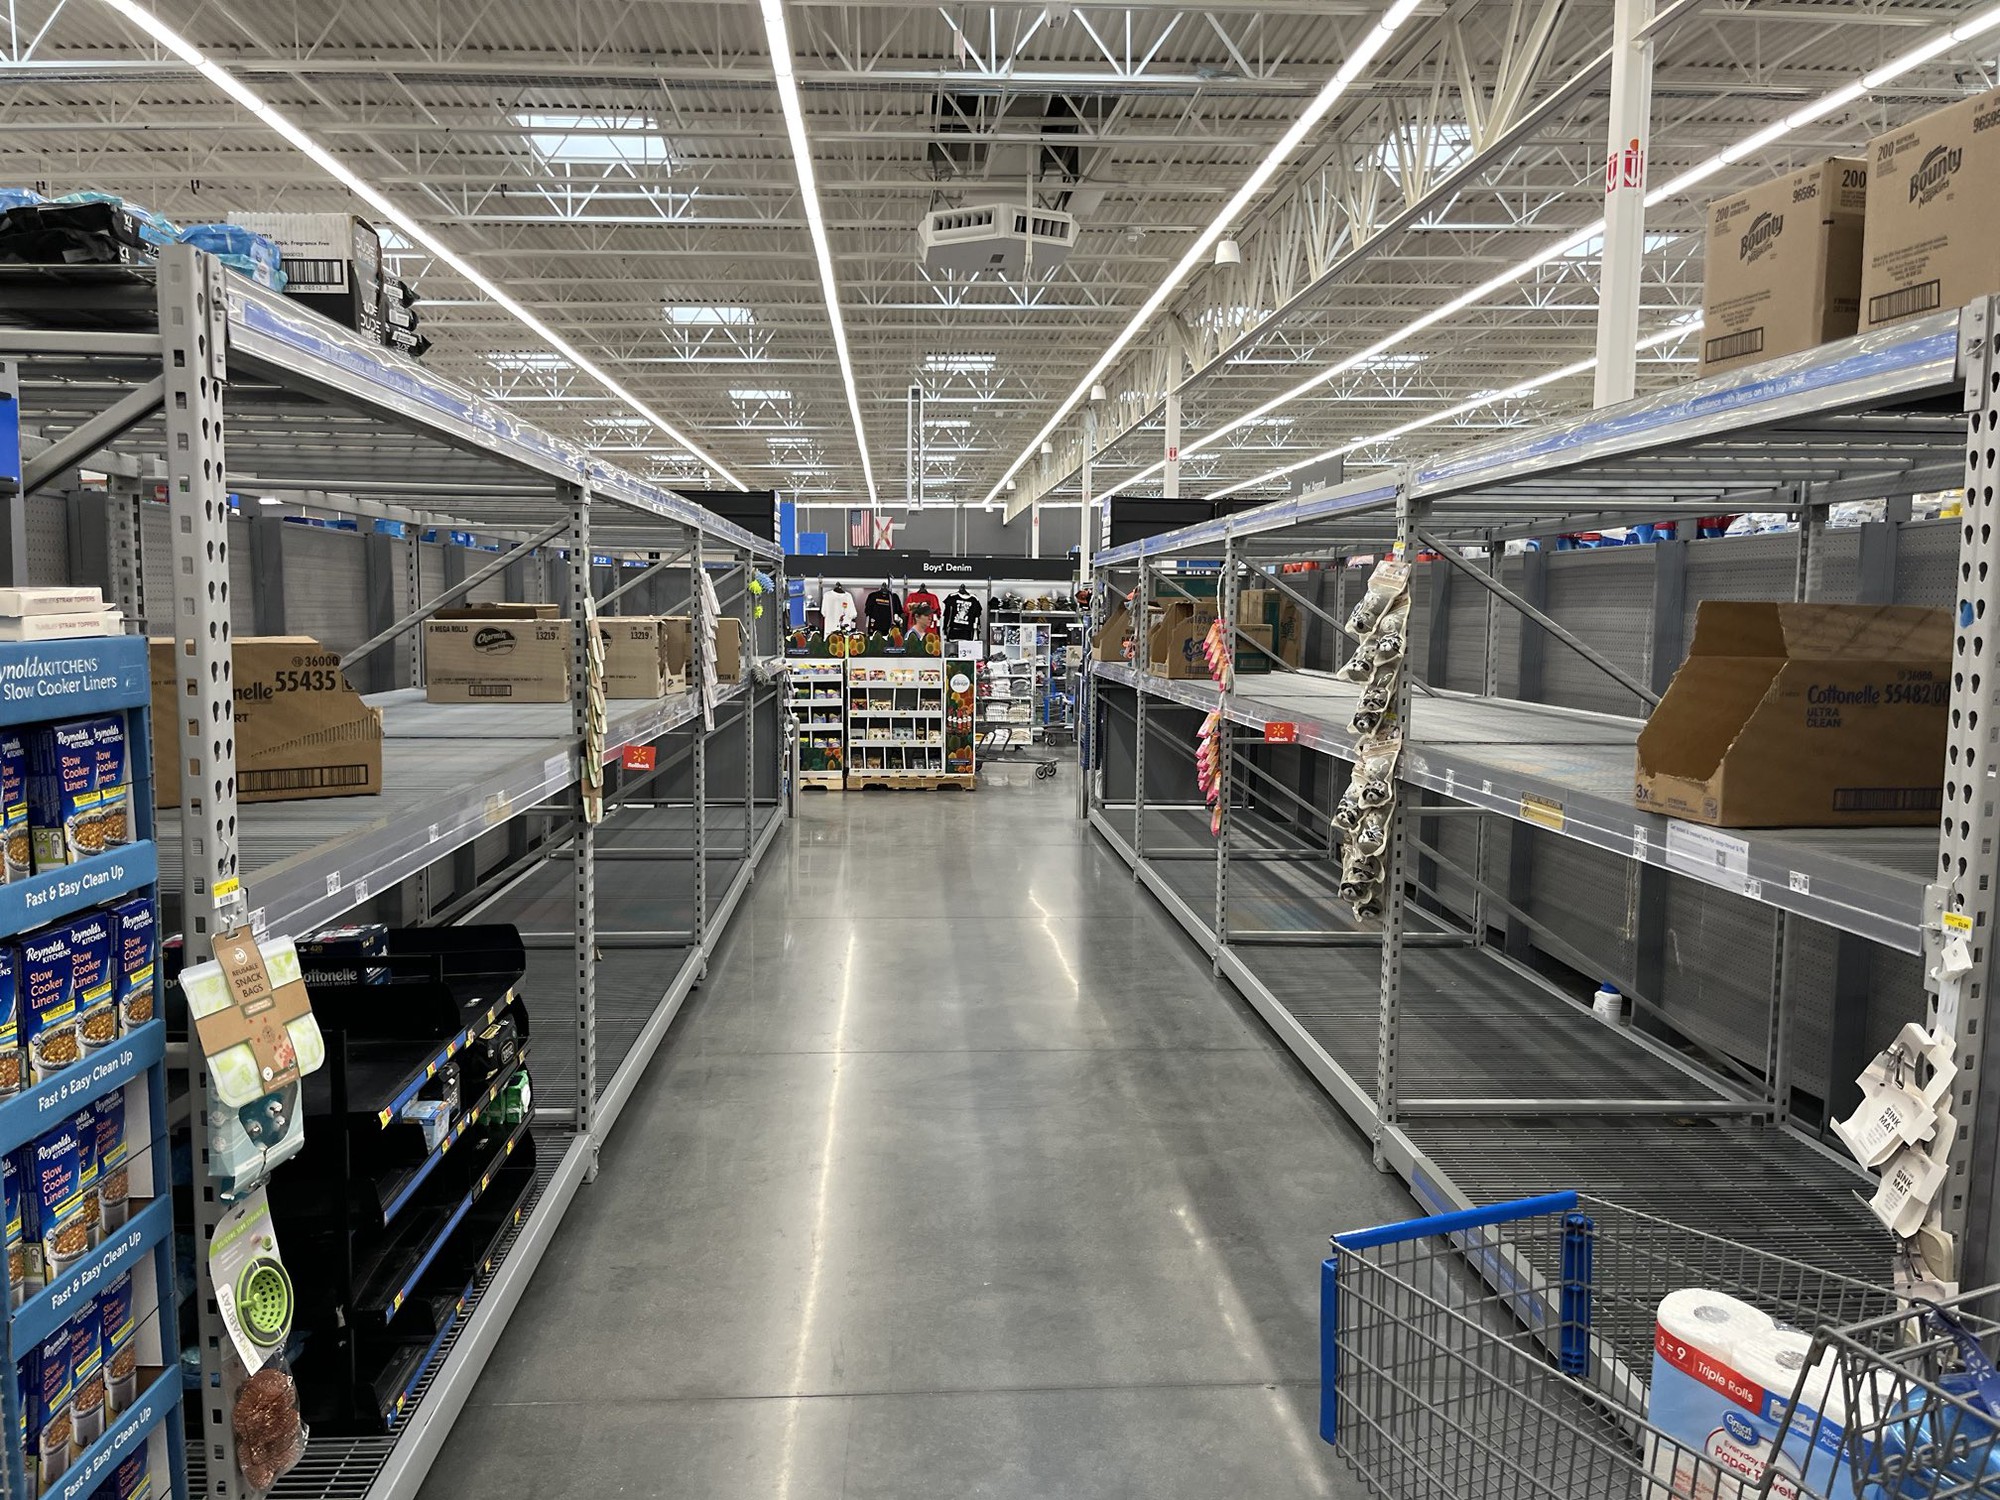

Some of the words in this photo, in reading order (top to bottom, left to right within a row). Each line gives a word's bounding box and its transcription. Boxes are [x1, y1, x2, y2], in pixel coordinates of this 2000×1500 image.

[1878, 142, 1894, 161] 200
[1842, 169, 1867, 188] 200
[1909, 147, 1962, 204] Bounty
[1715, 206, 1729, 223] 200
[1740, 213, 1784, 260] Bounty
[360, 313, 381, 334] DUDE
[361, 330, 381, 344] WIPES
[1753, 388, 1762, 397] on
[1764, 384, 1774, 395] the
[599, 556, 607, 564] 22
[923, 562, 944, 573] Boys'
[946, 562, 972, 573] Denim
[74, 595, 95, 603] TOPPERS
[77, 620, 100, 628] TOPPERS
[435, 625, 450, 633] MEGA
[452, 625, 469, 633] ROLLS
[477, 631, 507, 644] Charmin
[536, 631, 556, 640] 13219
[630, 631, 649, 640] 13219
[305, 656, 339, 667] 36000
[4, 682, 35, 701] Slow
[37, 677, 80, 698] Cooker
[83, 675, 117, 692] Liners
[275, 670, 336, 692] 55435
[233, 682, 274, 700] nelle
[1807, 684, 1881, 705] Cottonelle
[1884, 684, 1931, 705] 55482
[1807, 708, 1839, 717] ULTRA
[1807, 718, 1841, 728] CLEAN
[57, 729, 88, 746] Reynolds
[71, 739, 94, 749] KITCHENS
[102, 734, 124, 744] KITCHENS
[62, 756, 81, 768] Slow
[63, 766, 90, 779] Cooker
[64, 779, 88, 792] Liners
[26, 889, 48, 908] Fast
[49, 886, 57, 900] &
[58, 881, 81, 898] Easy
[82, 871, 110, 889] Clean
[110, 865, 124, 879] Up
[122, 909, 150, 929] Reynolds
[134, 917, 153, 931] KITCHENS
[82, 931, 107, 945] KITCHENS
[124, 937, 141, 950] Slow
[25, 940, 65, 962] Reynolds
[42, 948, 71, 964] KITCHENS
[72, 951, 92, 965] Slow
[124, 944, 147, 960] Cooker
[72, 960, 101, 977] Cooker
[124, 957, 144, 972] Liners
[232, 963, 259, 976] REUSABLE
[30, 969, 53, 985] Slow
[74, 973, 98, 989] Liners
[235, 972, 263, 988] SNACK
[303, 968, 358, 982] ottonelle
[31, 977, 63, 997] Cooker
[242, 984, 263, 998] BAGS
[32, 992, 60, 1009] Liners
[39, 1089, 59, 1112] Fast
[60, 1082, 68, 1098] &
[69, 1074, 90, 1095] Easy
[93, 1060, 118, 1081] Clean
[120, 1050, 133, 1067] Up
[95, 1090, 119, 1113] Reynolds
[96, 1118, 112, 1133] Slow
[1879, 1115, 1895, 1133] MAT
[1885, 1107, 1901, 1127] SINK
[96, 1124, 119, 1144] Cooker
[37, 1133, 72, 1161] Reynolds
[52, 1140, 77, 1161] KITCHENS
[97, 1138, 116, 1155] Liners
[42, 1164, 63, 1182] Slow
[1896, 1169, 1913, 1190] SINK
[43, 1171, 72, 1194] Cooker
[1892, 1179, 1909, 1197] MAT
[44, 1185, 70, 1206] Liners
[52, 1288, 71, 1309] Fast
[73, 1278, 80, 1293] &
[81, 1265, 102, 1287] Easy
[103, 1244, 128, 1268] Clean
[128, 1230, 141, 1248] Up
[103, 1299, 119, 1315] Slow
[103, 1303, 125, 1326] Cooker
[104, 1317, 123, 1337] Liners
[43, 1328, 69, 1359] Reynolds
[1660, 1336, 1665, 1347] 3
[1676, 1347, 1687, 1360] 9
[44, 1360, 60, 1381] Slow
[44, 1366, 66, 1391] Cooker
[1698, 1362, 1726, 1386] Triple
[1728, 1380, 1753, 1403] Rolls
[44, 1381, 62, 1403] Liners
[1726, 1414, 1753, 1437] Great
[1731, 1425, 1752, 1441] Value
[64, 1480, 84, 1500] Fast
[85, 1466, 92, 1480] &
[93, 1444, 113, 1467] Easy
[114, 1422, 139, 1449] Clean
[140, 1407, 151, 1424] Up
[1724, 1440, 1759, 1466] Everyday
[119, 1459, 135, 1476] Slow
[120, 1463, 141, 1486] Cooker
[1715, 1445, 1752, 1475] Paper
[1754, 1469, 1798, 1500] Twels
